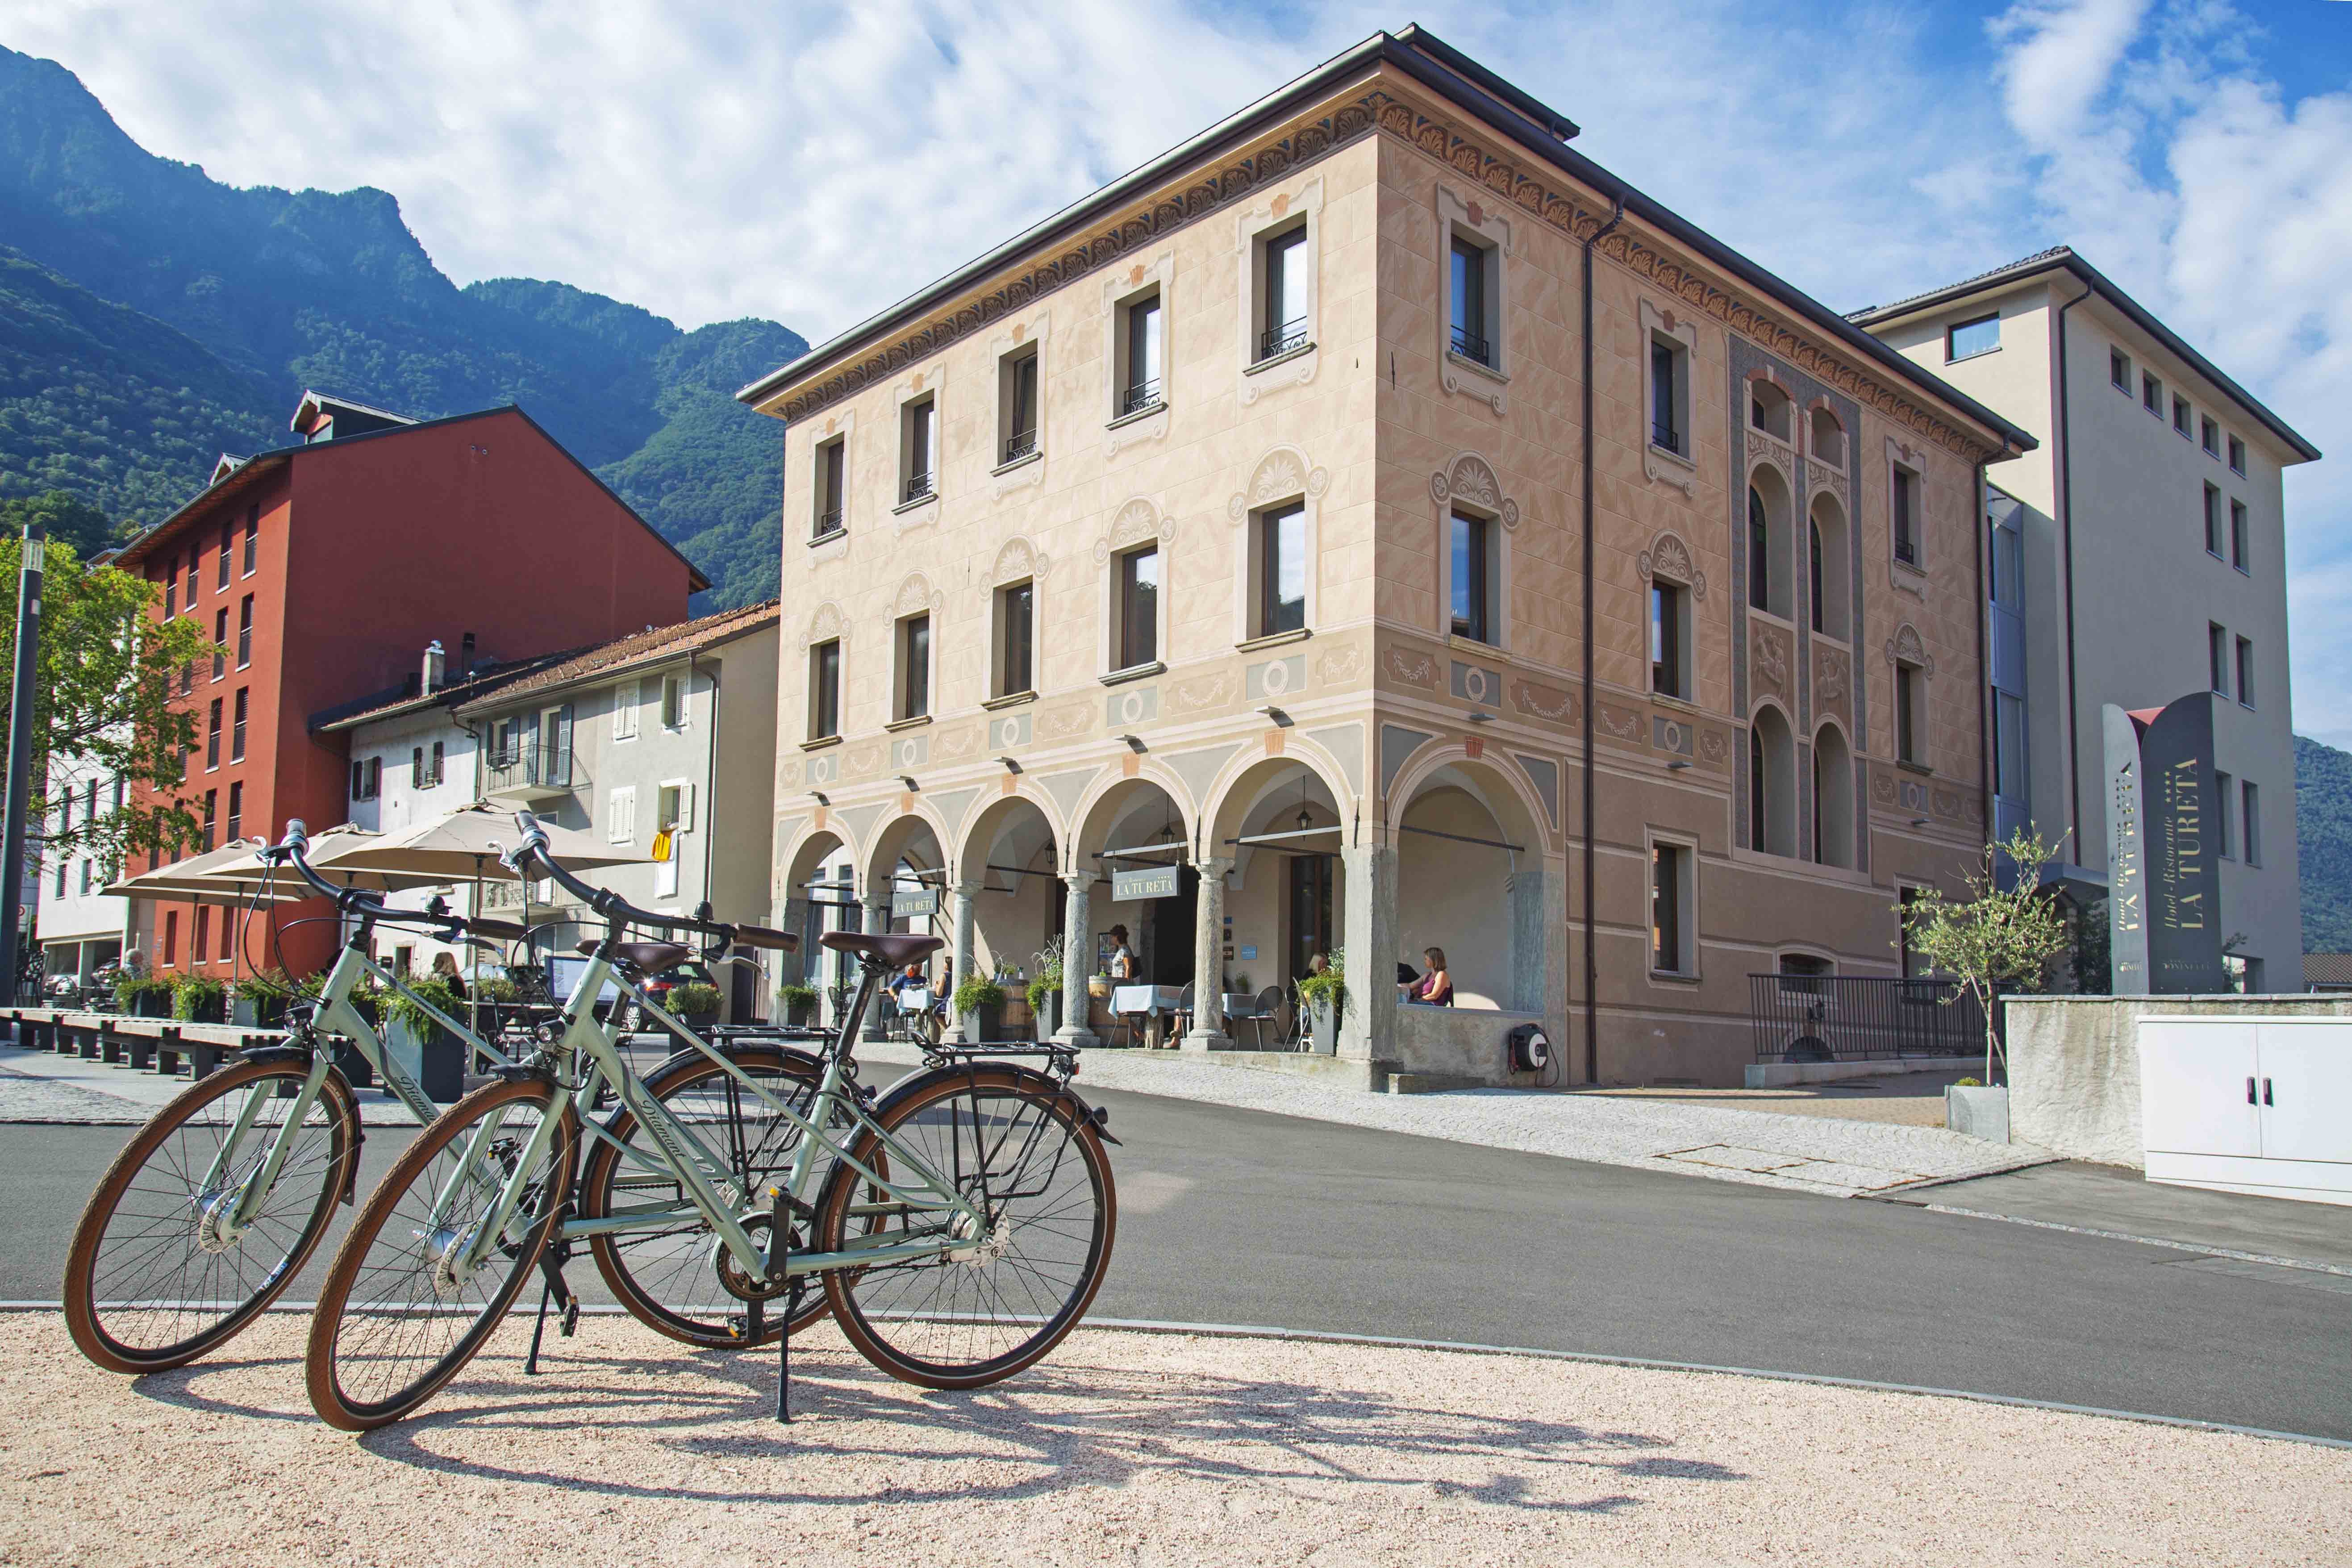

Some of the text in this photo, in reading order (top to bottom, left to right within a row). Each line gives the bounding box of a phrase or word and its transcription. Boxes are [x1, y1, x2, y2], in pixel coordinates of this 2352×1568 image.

[2163, 816, 2176, 884] Ristorante
[2174, 757, 2204, 929] LA TURETA
[895, 899, 934, 913] LA TURETA
[1117, 884, 1129, 896] LA
[1131, 880, 1173, 894] TURETA
[2126, 893, 2140, 930] LA
[2164, 893, 2178, 929] Hotel
[394, 1076, 437, 1121] Diama
[636, 1100, 687, 1158] Diamant
